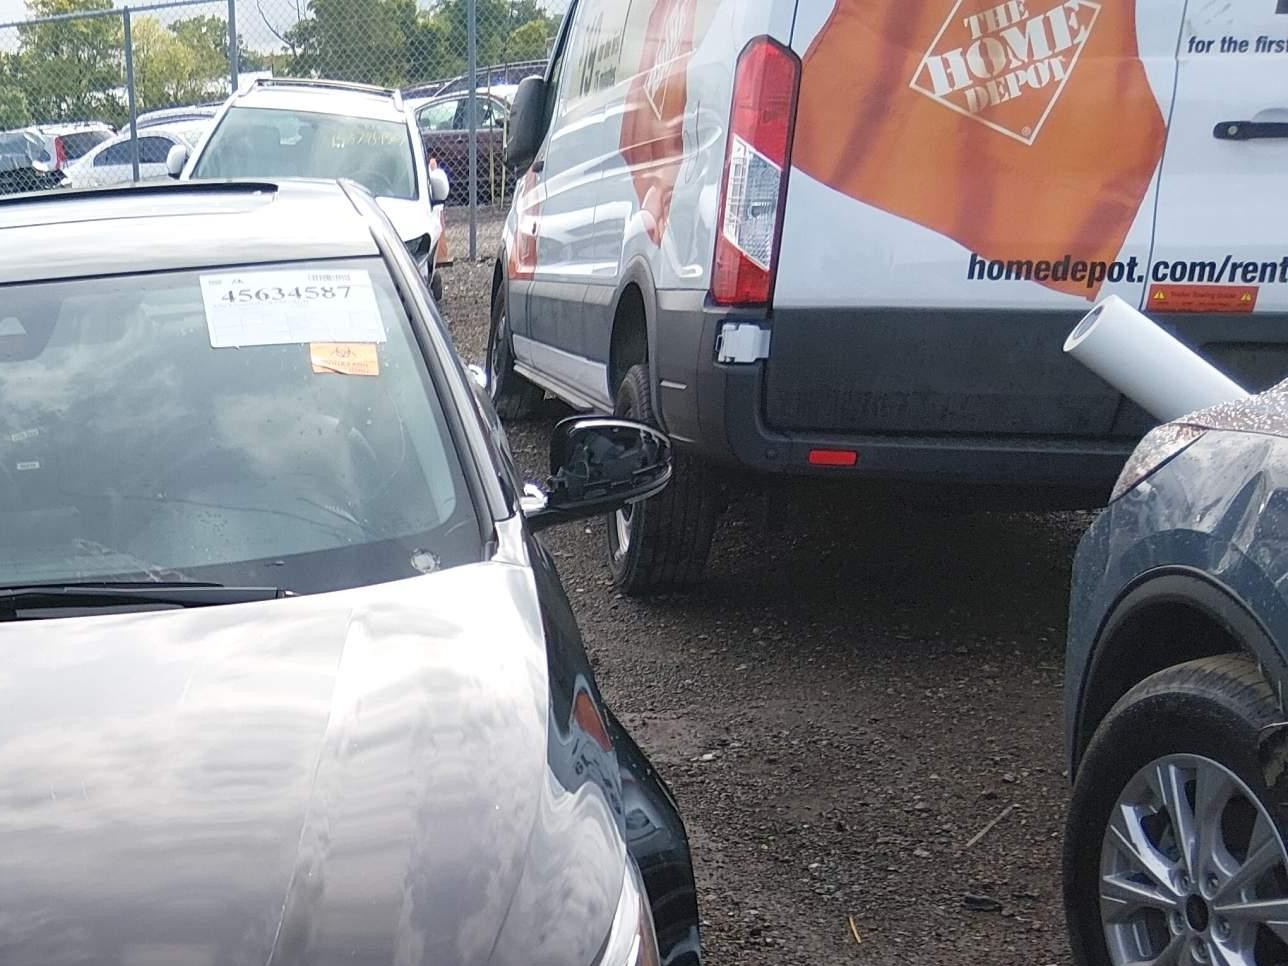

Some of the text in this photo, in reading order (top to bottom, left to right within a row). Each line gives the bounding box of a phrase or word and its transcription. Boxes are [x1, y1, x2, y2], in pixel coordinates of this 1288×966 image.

[964, 0, 1029, 39] THE
[925, 0, 1087, 97] HOME
[1187, 35, 1288, 53] for the firs
[964, 56, 1066, 113] DEPOT
[221, 286, 352, 302] 45634587
